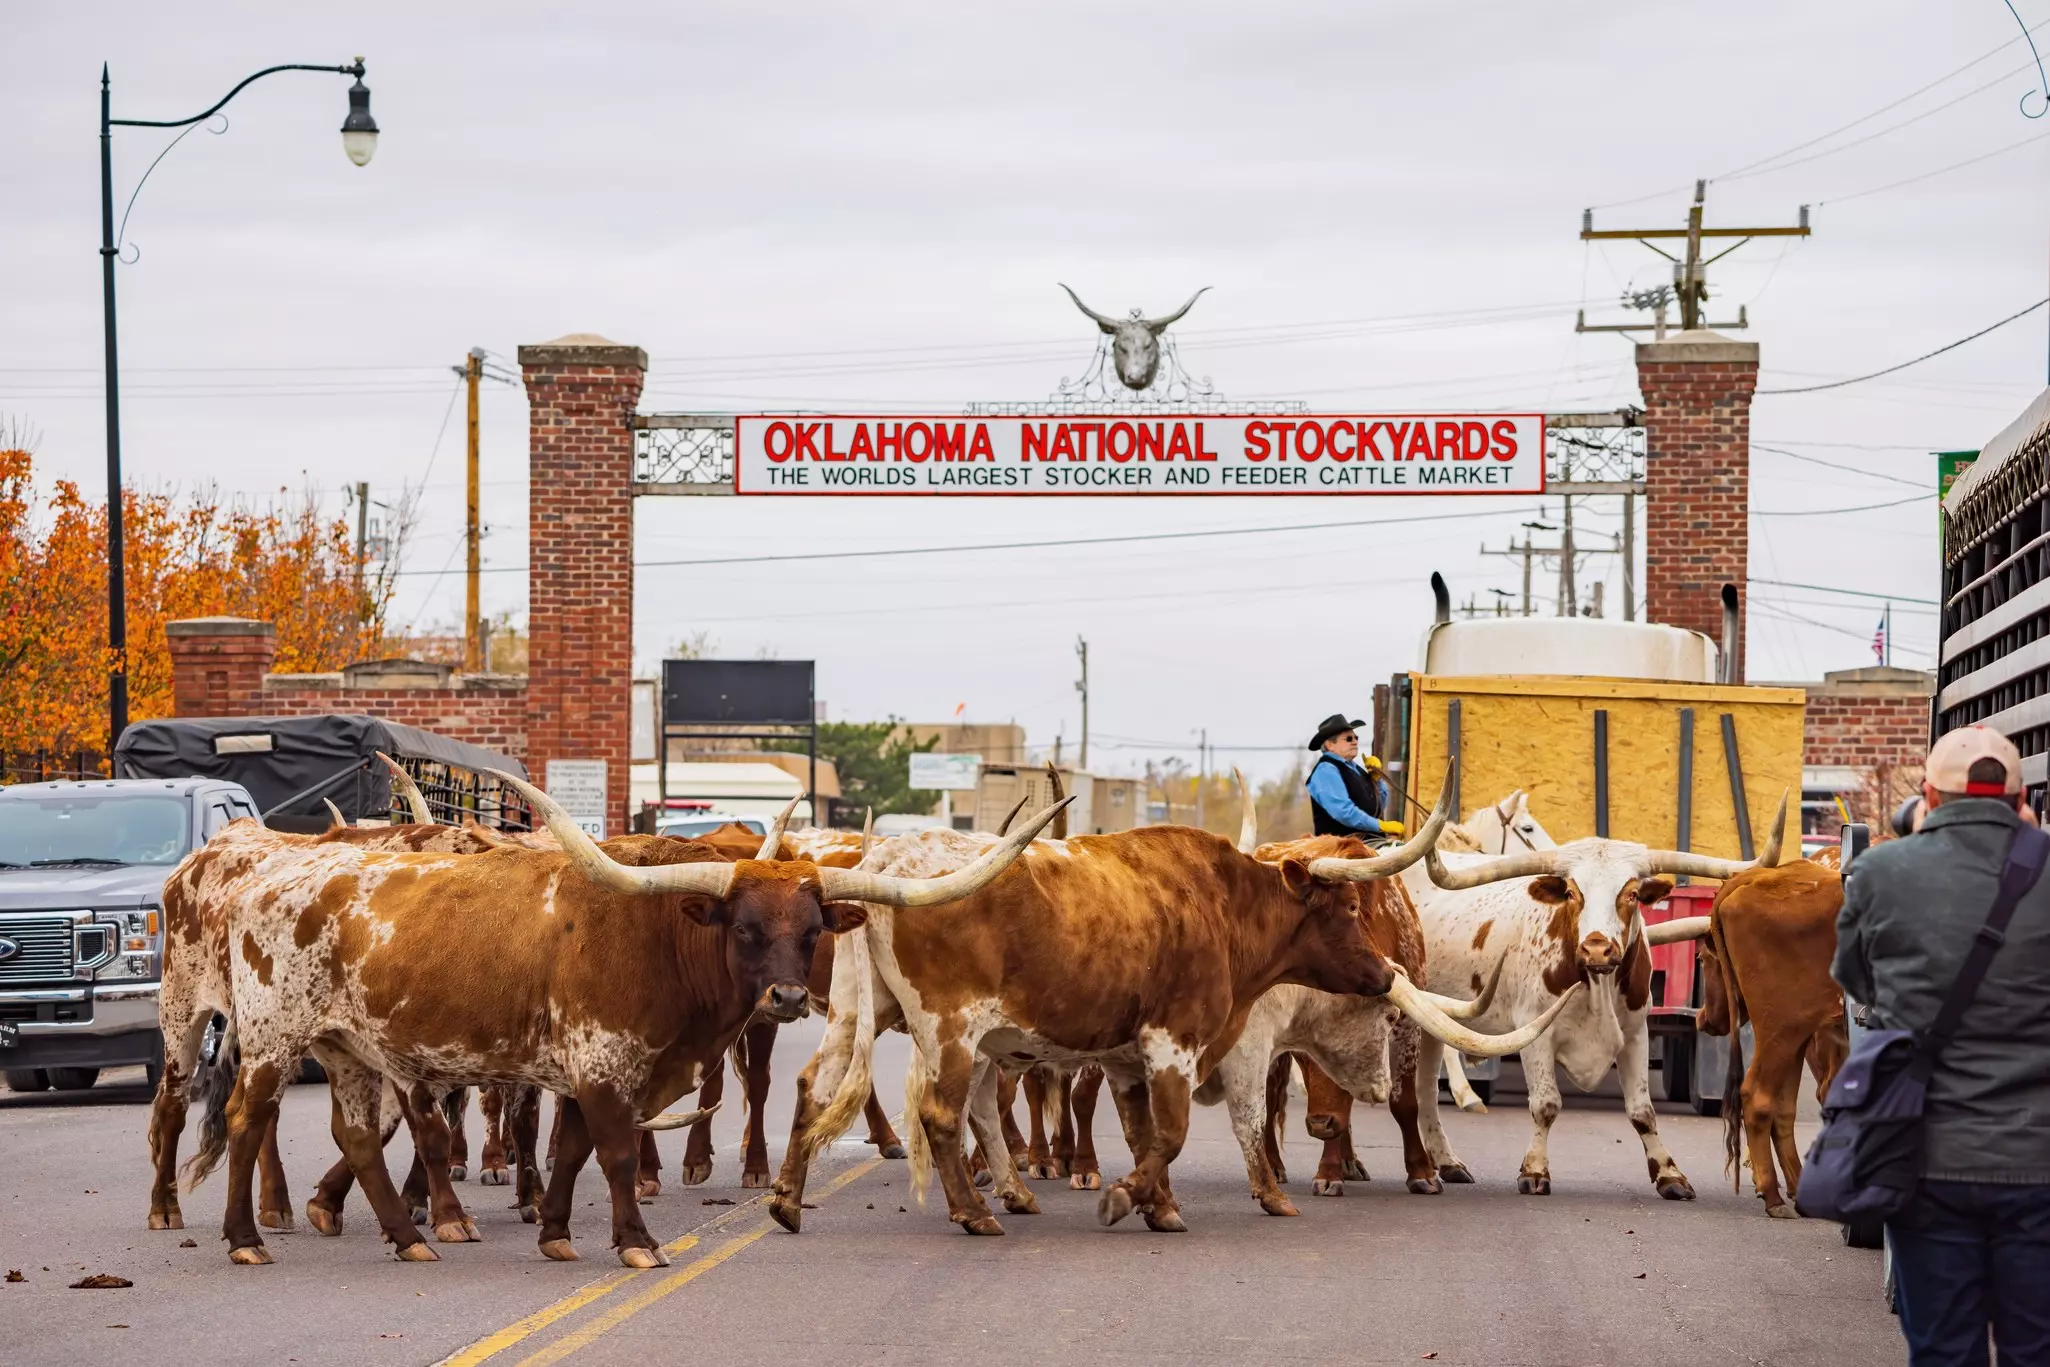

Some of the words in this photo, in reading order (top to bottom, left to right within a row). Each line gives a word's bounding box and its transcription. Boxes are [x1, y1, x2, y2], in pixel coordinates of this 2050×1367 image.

[764, 421, 995, 463] OKLAHOMA
[1021, 421, 1217, 463] NATIONAL
[1244, 420, 1518, 463] STOCKYARDS
[766, 467, 809, 485] THE
[821, 467, 916, 485] WORLDS
[928, 467, 1033, 486] LARGEST
[1045, 467, 1152, 486] STOCKER
[1164, 467, 1210, 485] AND
[1222, 467, 1307, 485] FEEDER
[1319, 467, 1407, 485] CATTLE
[1419, 467, 1513, 484] MARKET
